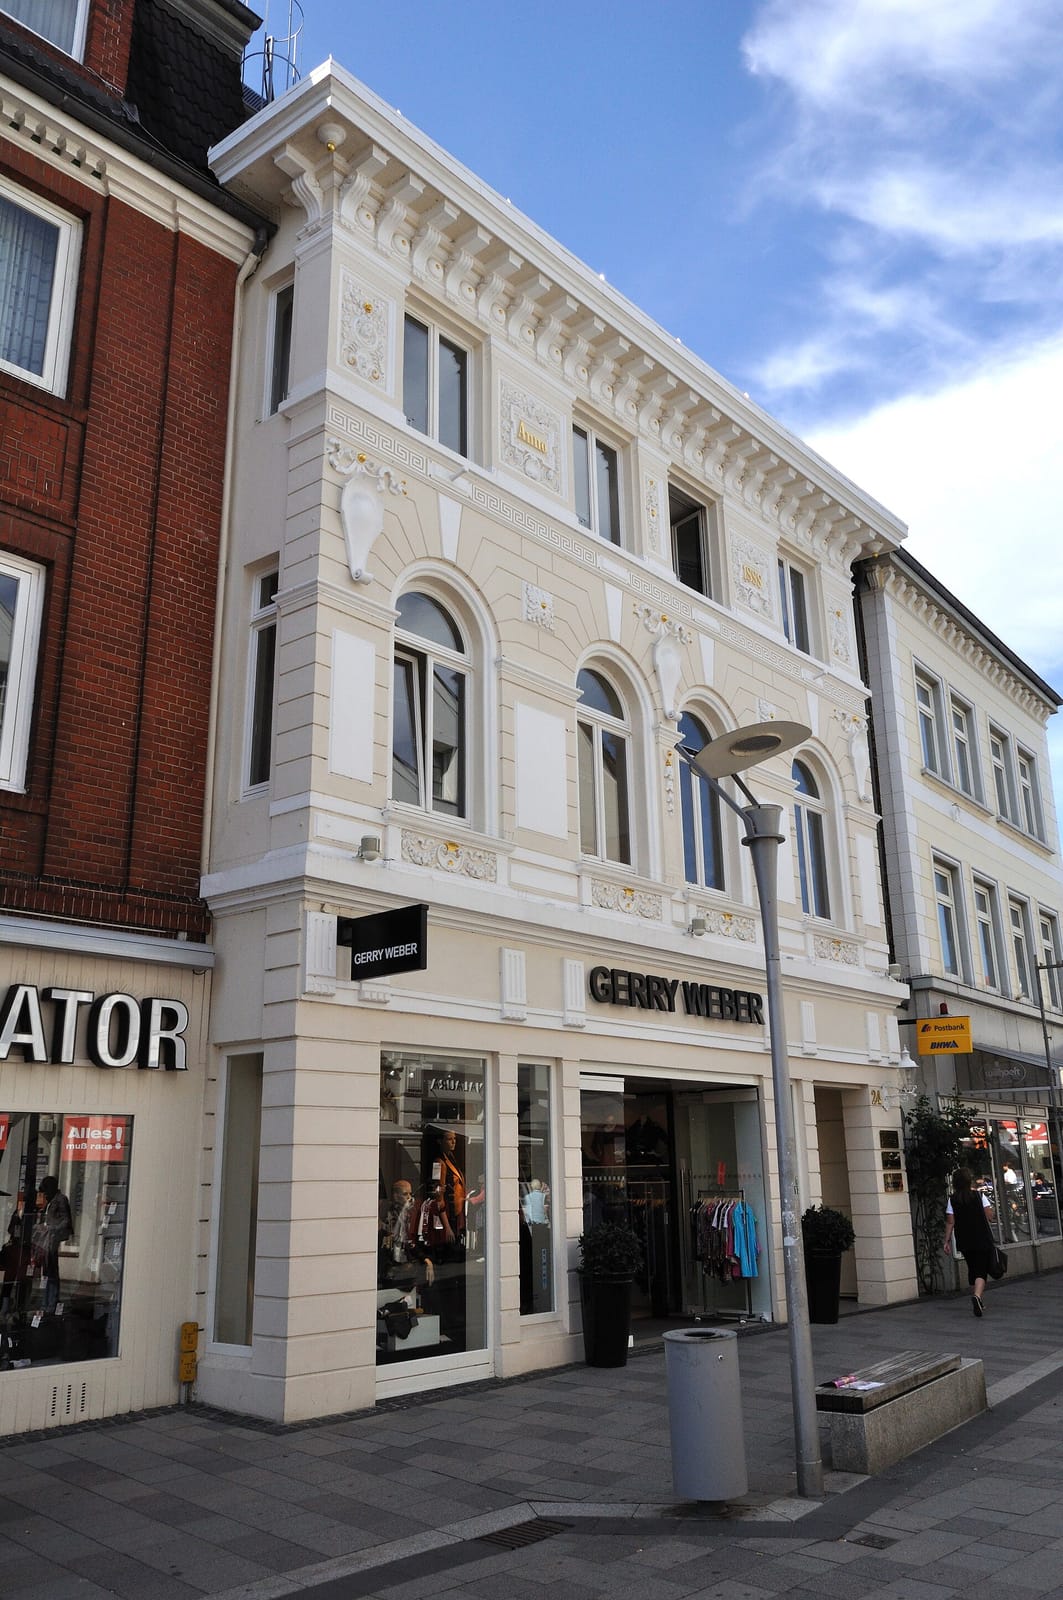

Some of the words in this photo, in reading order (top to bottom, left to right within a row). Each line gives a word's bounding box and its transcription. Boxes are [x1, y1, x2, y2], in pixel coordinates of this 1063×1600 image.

[518, 419, 547, 454] Anno
[354, 949, 384, 965] GERRY
[385, 942, 418, 959] WEBER
[590, 965, 679, 1012] GERRY
[682, 981, 765, 1025] WEBER
[0, 984, 189, 1071] ATOR
[934, 1023, 965, 1032] Postbank
[66, 1142, 87, 1150] muß
